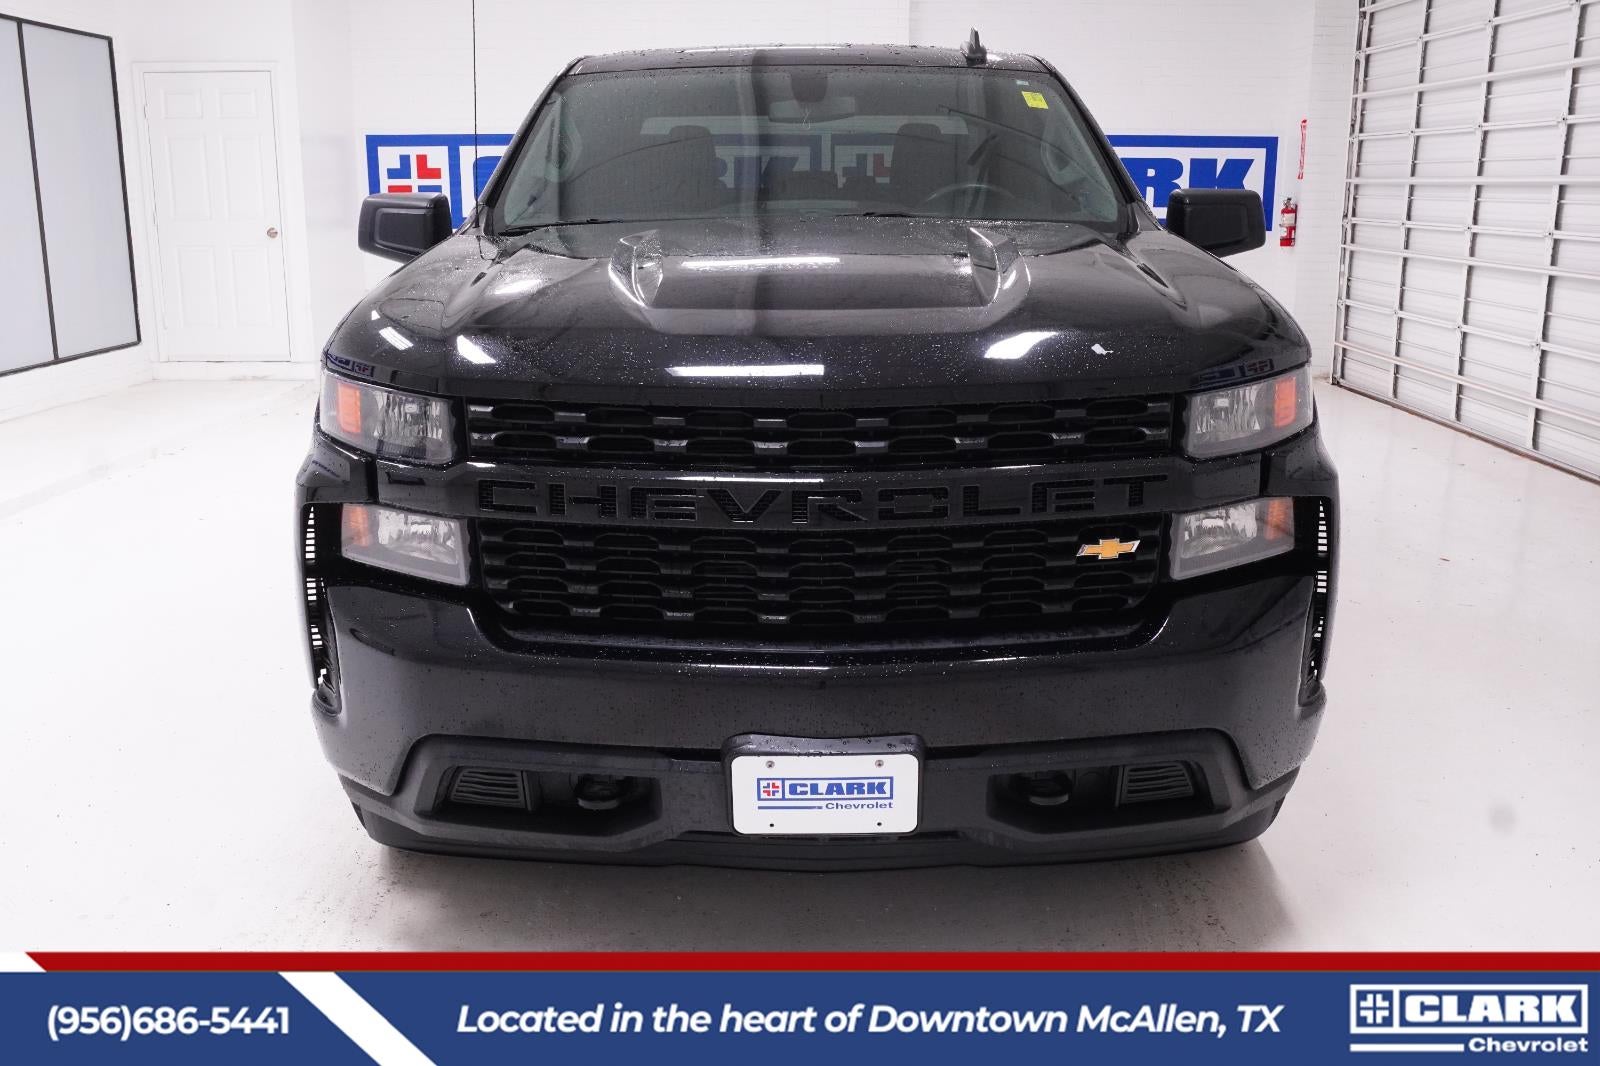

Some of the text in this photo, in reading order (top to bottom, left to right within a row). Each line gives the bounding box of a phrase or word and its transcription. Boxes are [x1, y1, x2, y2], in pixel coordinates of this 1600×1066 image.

[478, 474, 1169, 524] CHEVROLET
[788, 782, 887, 796] CLARK
[825, 801, 894, 810] Chevrolet
